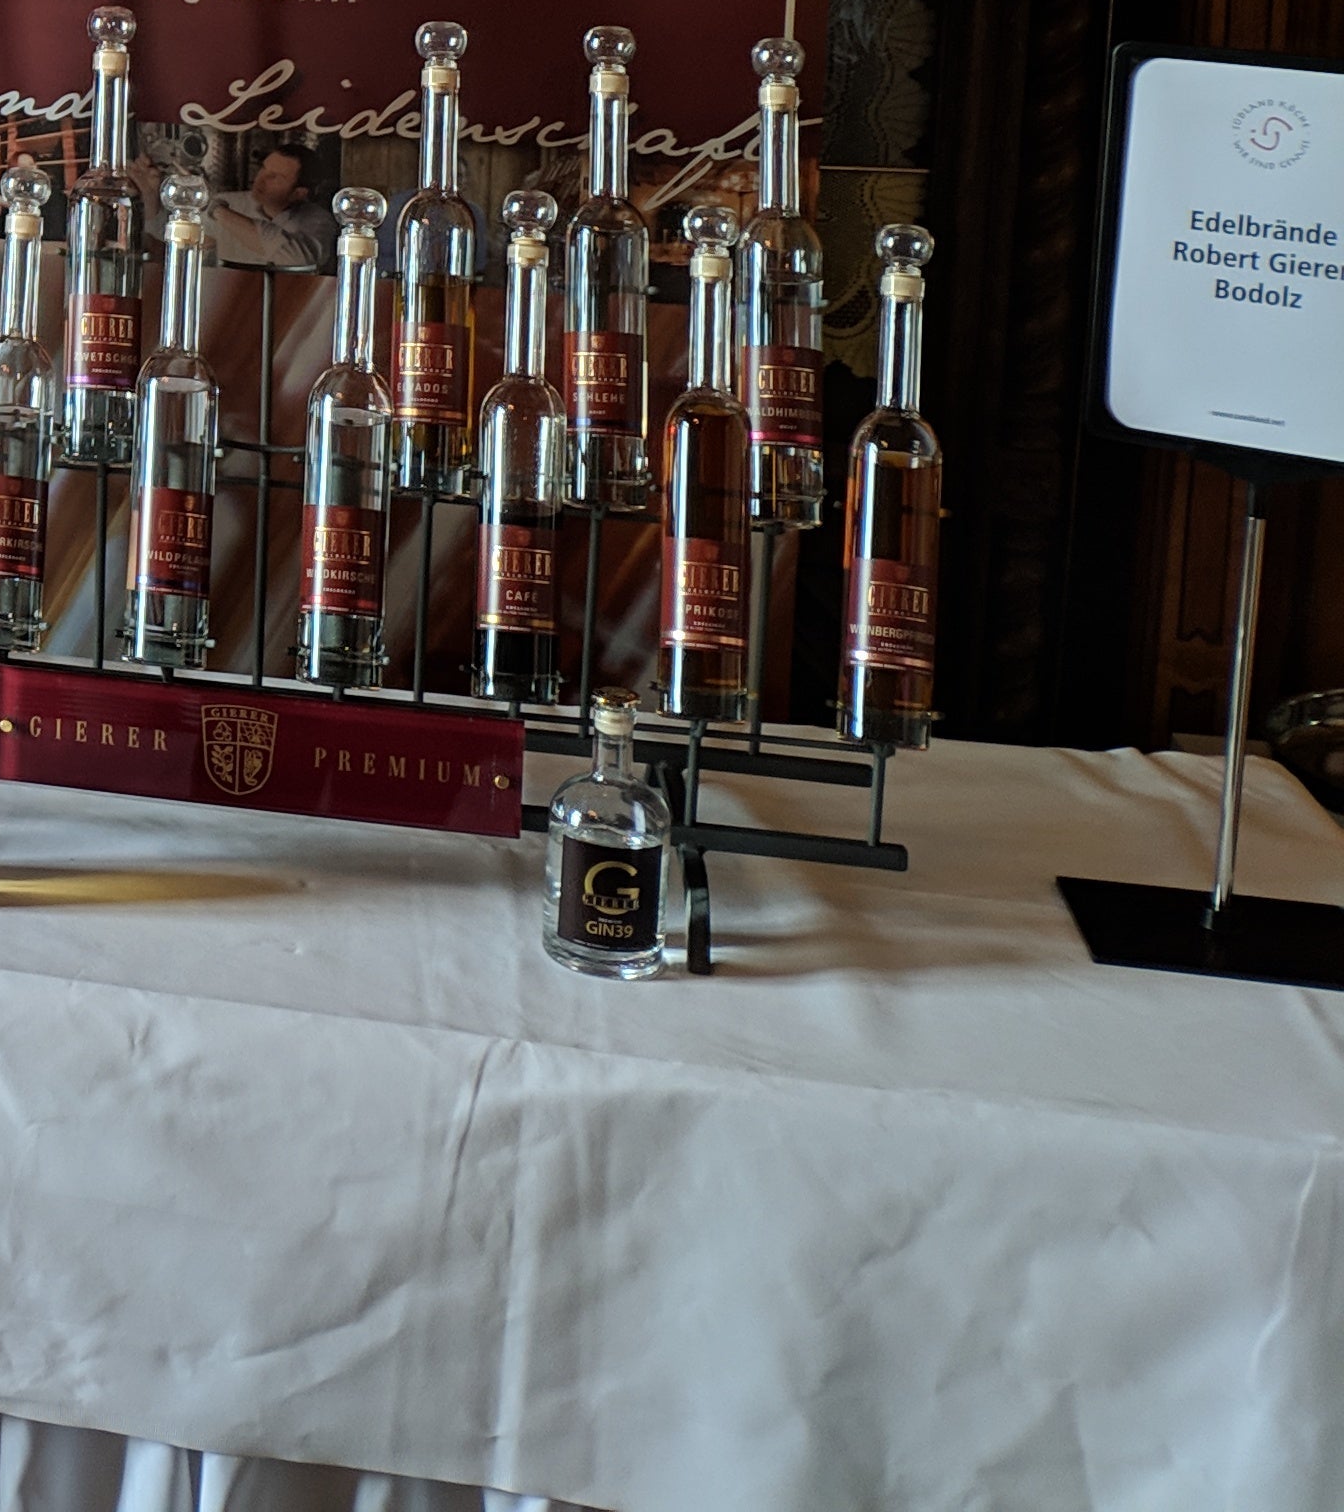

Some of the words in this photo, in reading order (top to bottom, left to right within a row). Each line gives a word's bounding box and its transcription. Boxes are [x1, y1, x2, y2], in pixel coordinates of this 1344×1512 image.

[1191, 210, 1338, 246] Edelbrände
[1173, 241, 1261, 271] Robert
[1214, 278, 1303, 309] Bodolz
[572, 392, 626, 405] SHLEHE
[29, 716, 169, 752] GIERER
[210, 706, 271, 723] GIERER
[314, 747, 483, 788] PREMIUM
[586, 920, 634, 939] GIN39
